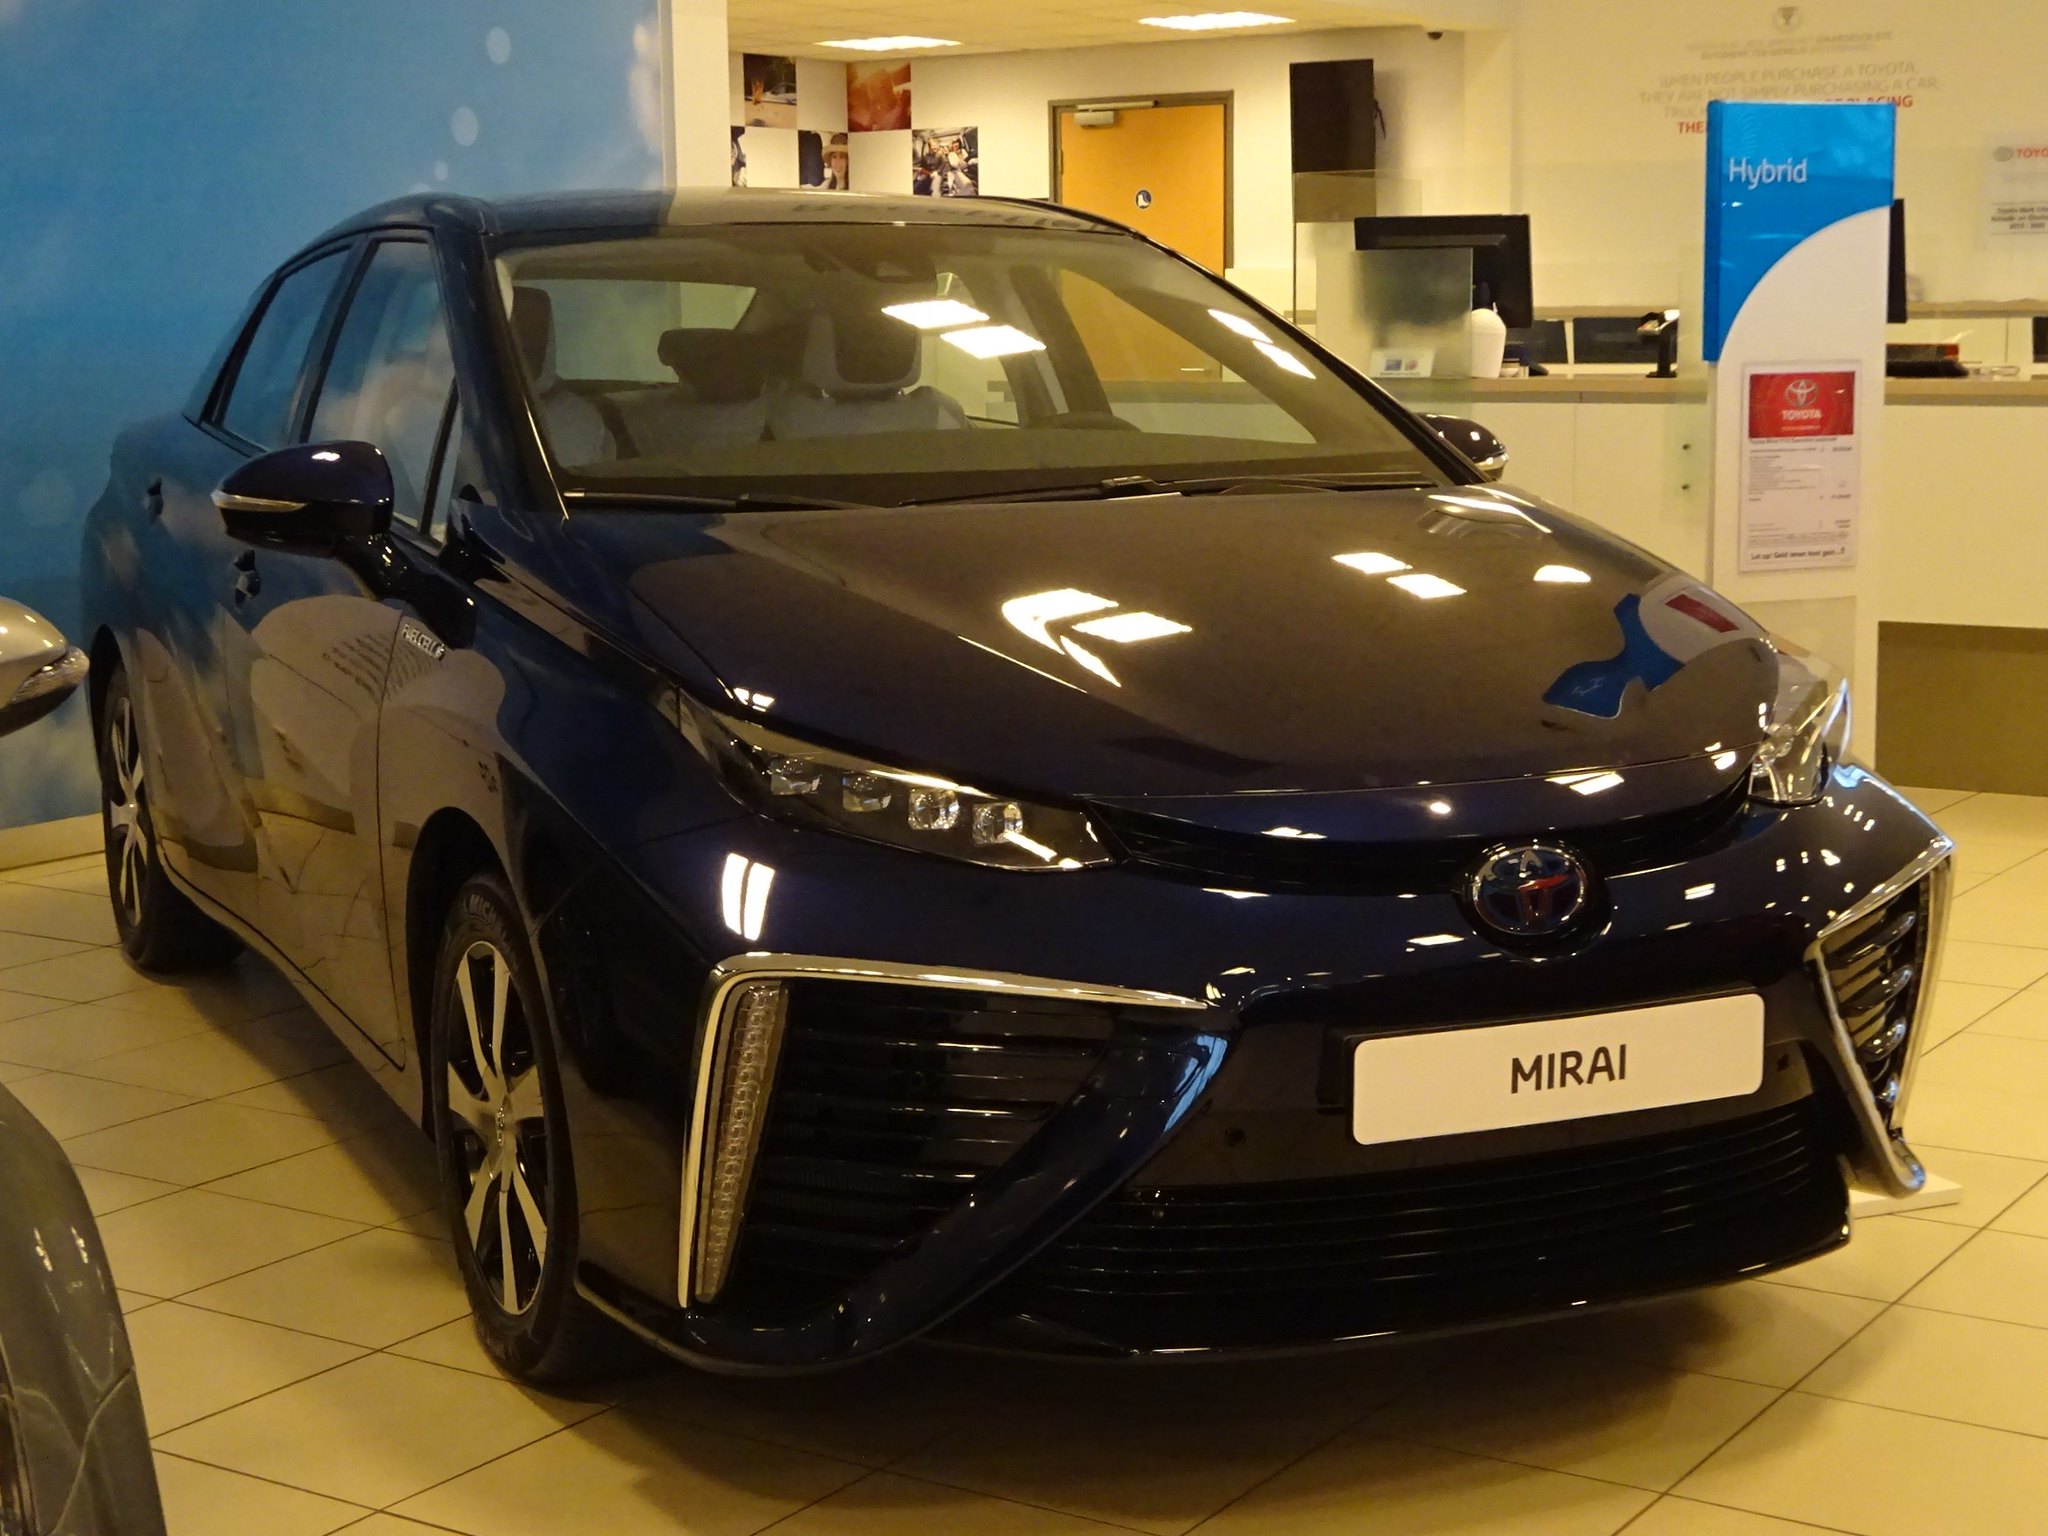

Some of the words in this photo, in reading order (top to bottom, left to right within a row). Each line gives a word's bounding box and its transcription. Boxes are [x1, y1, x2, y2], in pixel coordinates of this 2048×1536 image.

[1729, 157, 1808, 191] Hybrid
[1782, 409, 1822, 420] TOYOTA
[1510, 1043, 1627, 1095] MIRAI
